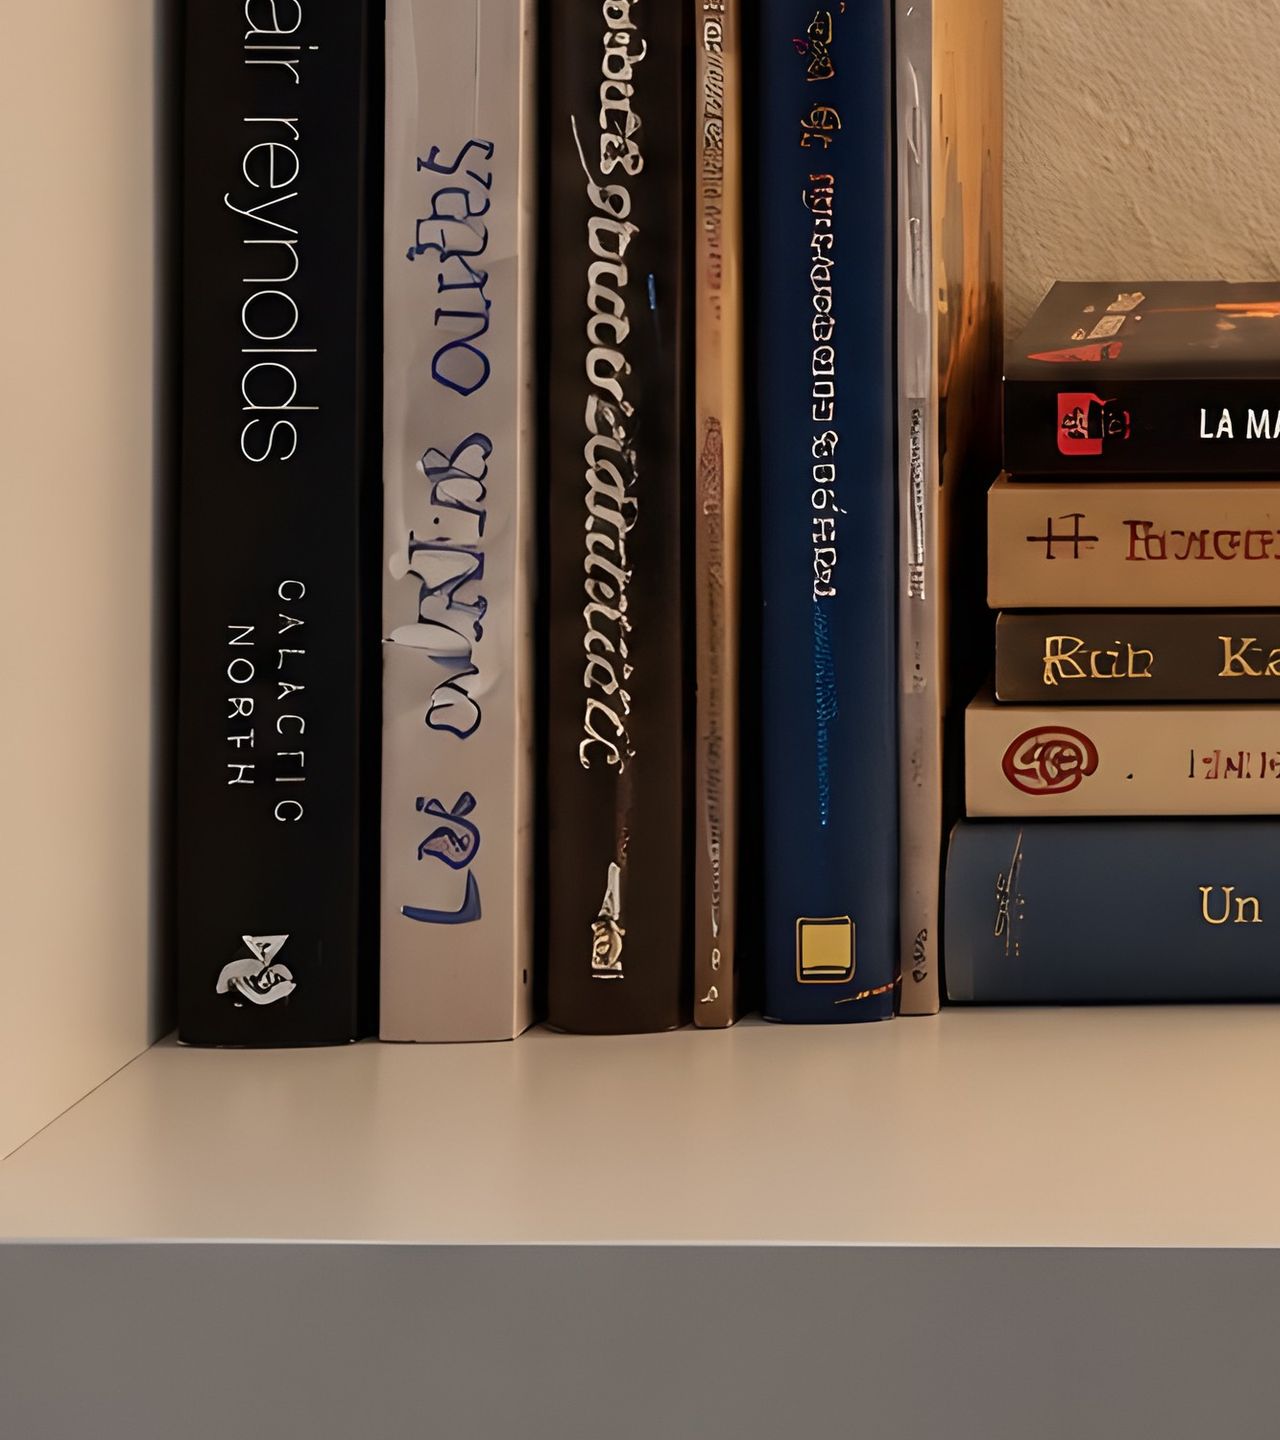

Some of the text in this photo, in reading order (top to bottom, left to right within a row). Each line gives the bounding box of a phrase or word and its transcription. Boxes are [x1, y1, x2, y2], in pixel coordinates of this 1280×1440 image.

[223, 117, 319, 463] reynolds
[1199, 407, 1235, 440] LA
[1198, 885, 1264, 925] Un
